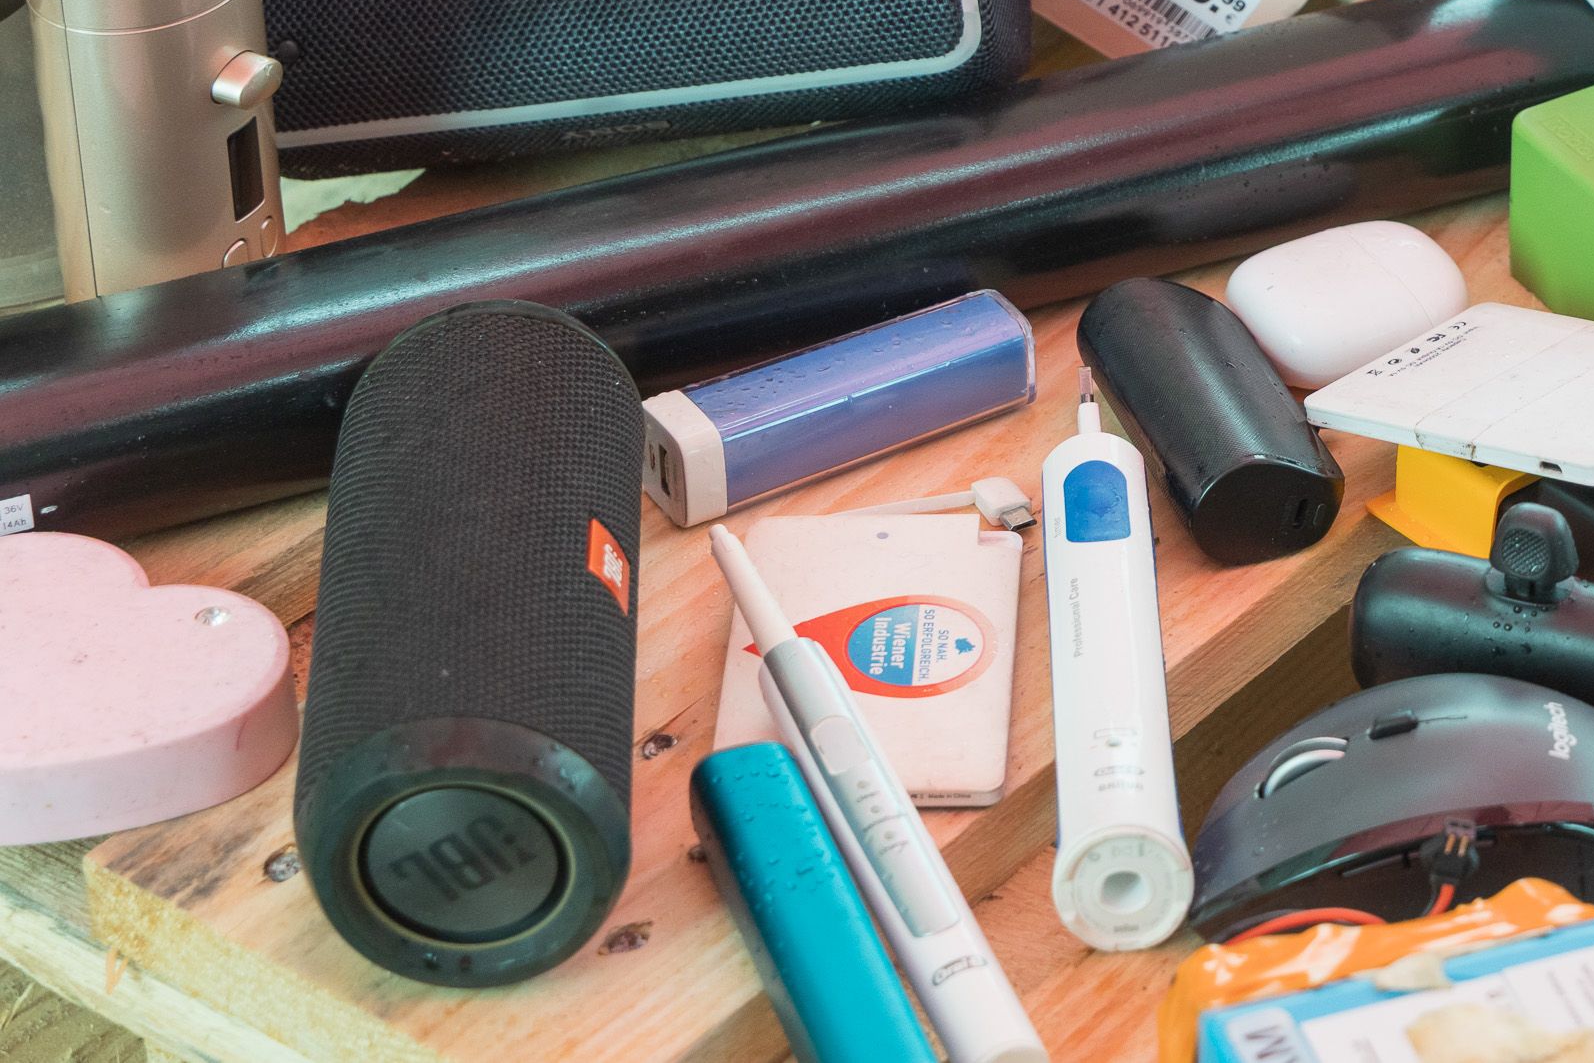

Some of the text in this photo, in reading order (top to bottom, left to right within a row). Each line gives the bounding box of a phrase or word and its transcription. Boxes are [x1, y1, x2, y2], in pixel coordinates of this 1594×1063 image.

[1108, 3, 1140, 28] 412
[3, 519, 27, 530] 14Ah
[4, 504, 24, 515] 36V
[1069, 576, 1084, 659] Professional Care
[869, 617, 892, 675] Industrie
[890, 622, 911, 668] Wiener
[918, 609, 934, 681] SO ERFOLGREICH.
[935, 629, 948, 662] SO NAH.
[1543, 701, 1578, 761] logitech
[389, 813, 518, 903] JBL
